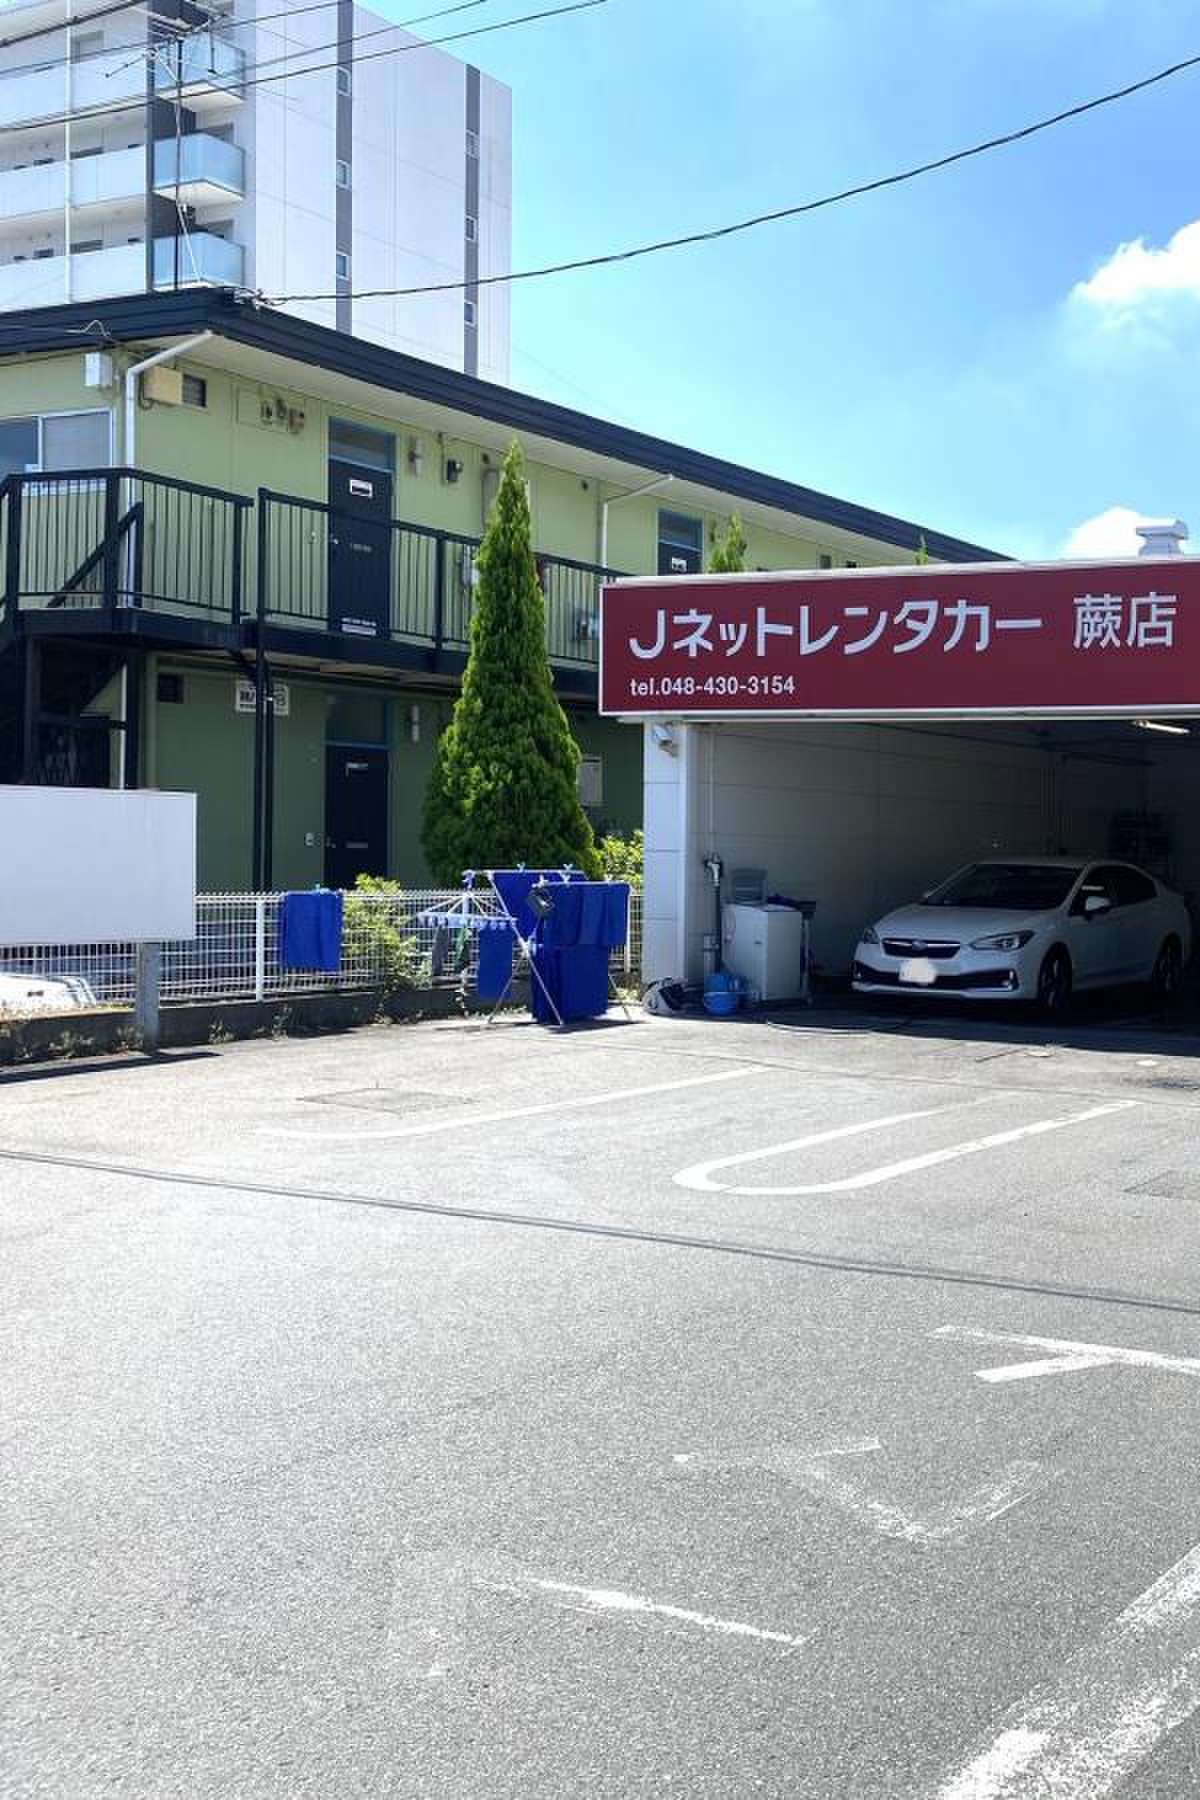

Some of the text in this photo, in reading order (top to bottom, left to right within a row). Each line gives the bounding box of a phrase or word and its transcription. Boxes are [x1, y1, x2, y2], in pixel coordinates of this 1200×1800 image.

[629, 592, 1177, 659] Jネットレンタカー 蕨店
[630, 675, 795, 697] tel.048-430-3154
